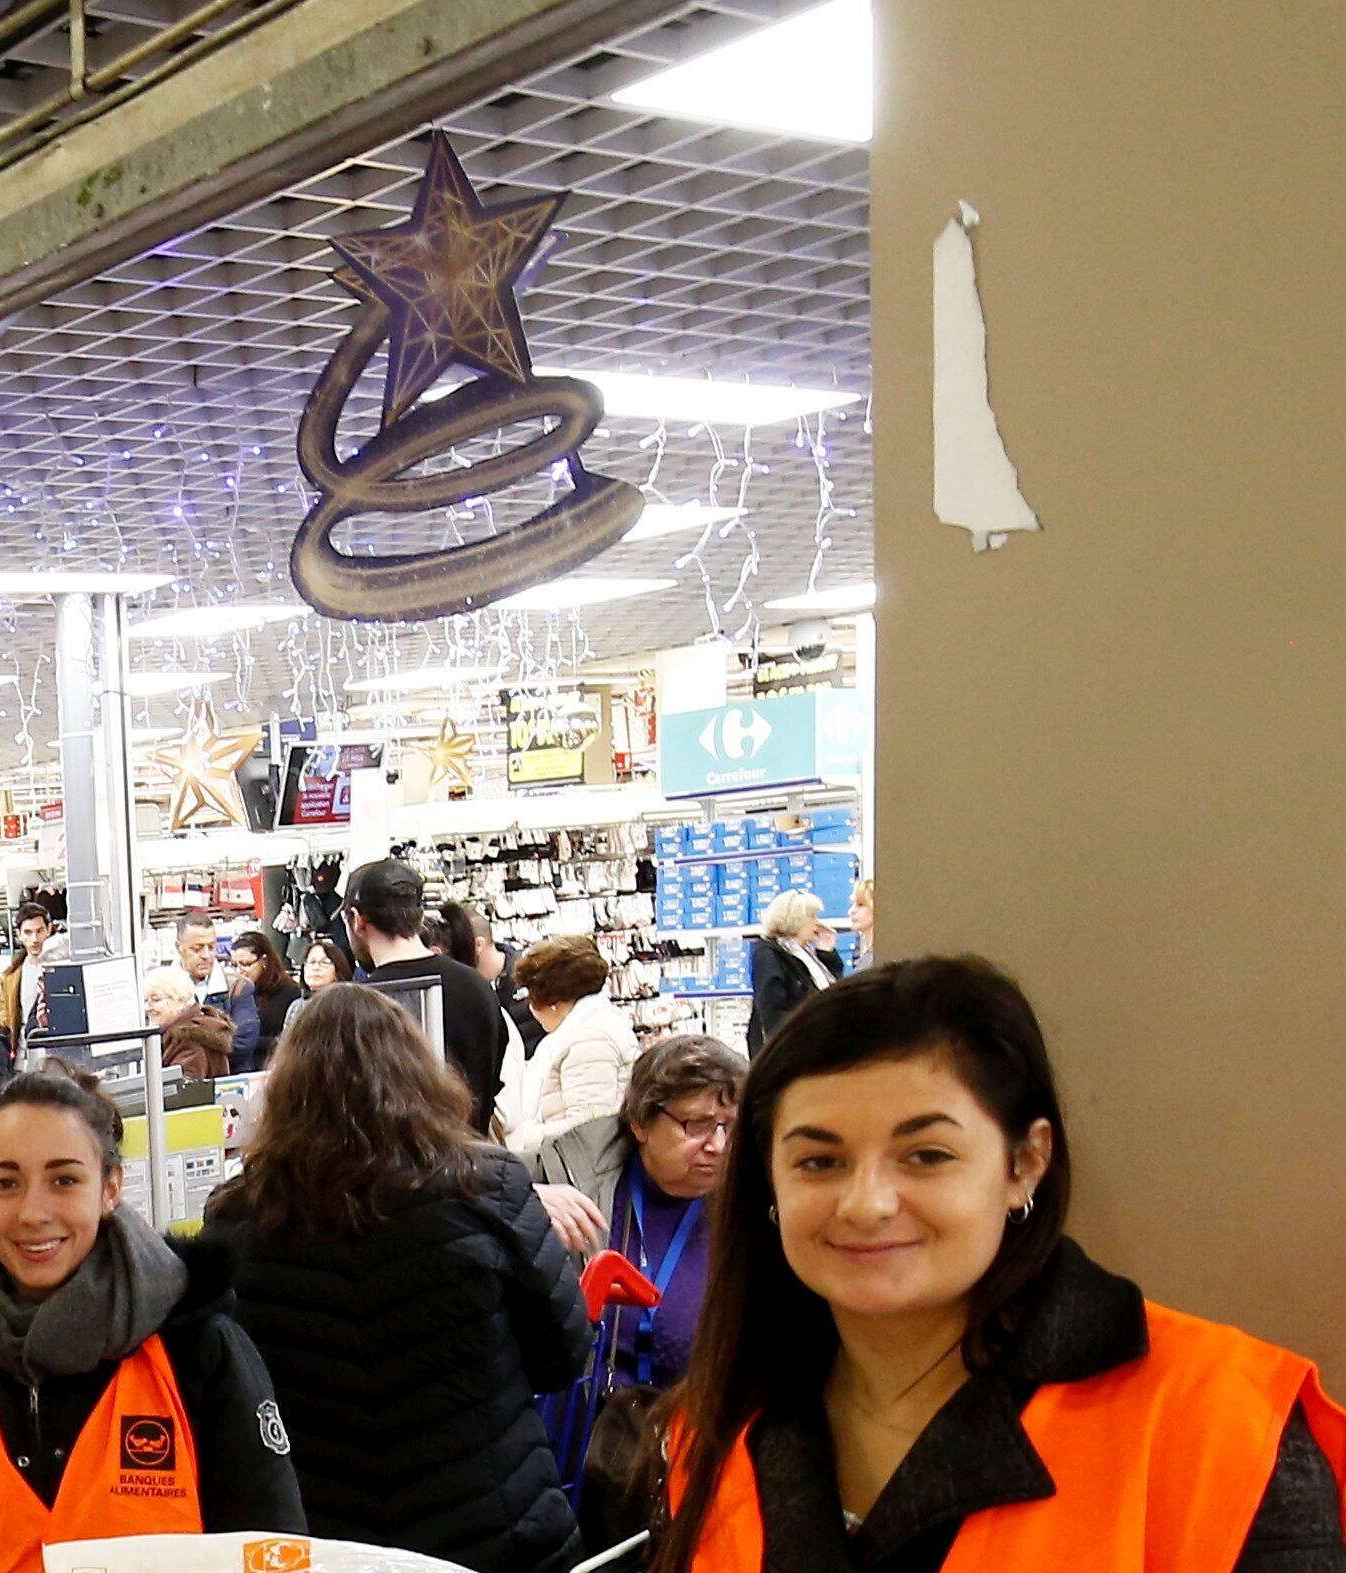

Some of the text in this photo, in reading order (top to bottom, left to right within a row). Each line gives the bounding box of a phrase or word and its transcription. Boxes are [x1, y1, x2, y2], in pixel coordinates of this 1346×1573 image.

[707, 767, 767, 785] Carrefour
[119, 1474, 176, 1486] BANQUES
[109, 1486, 187, 1498] ALIMENTAIRES
